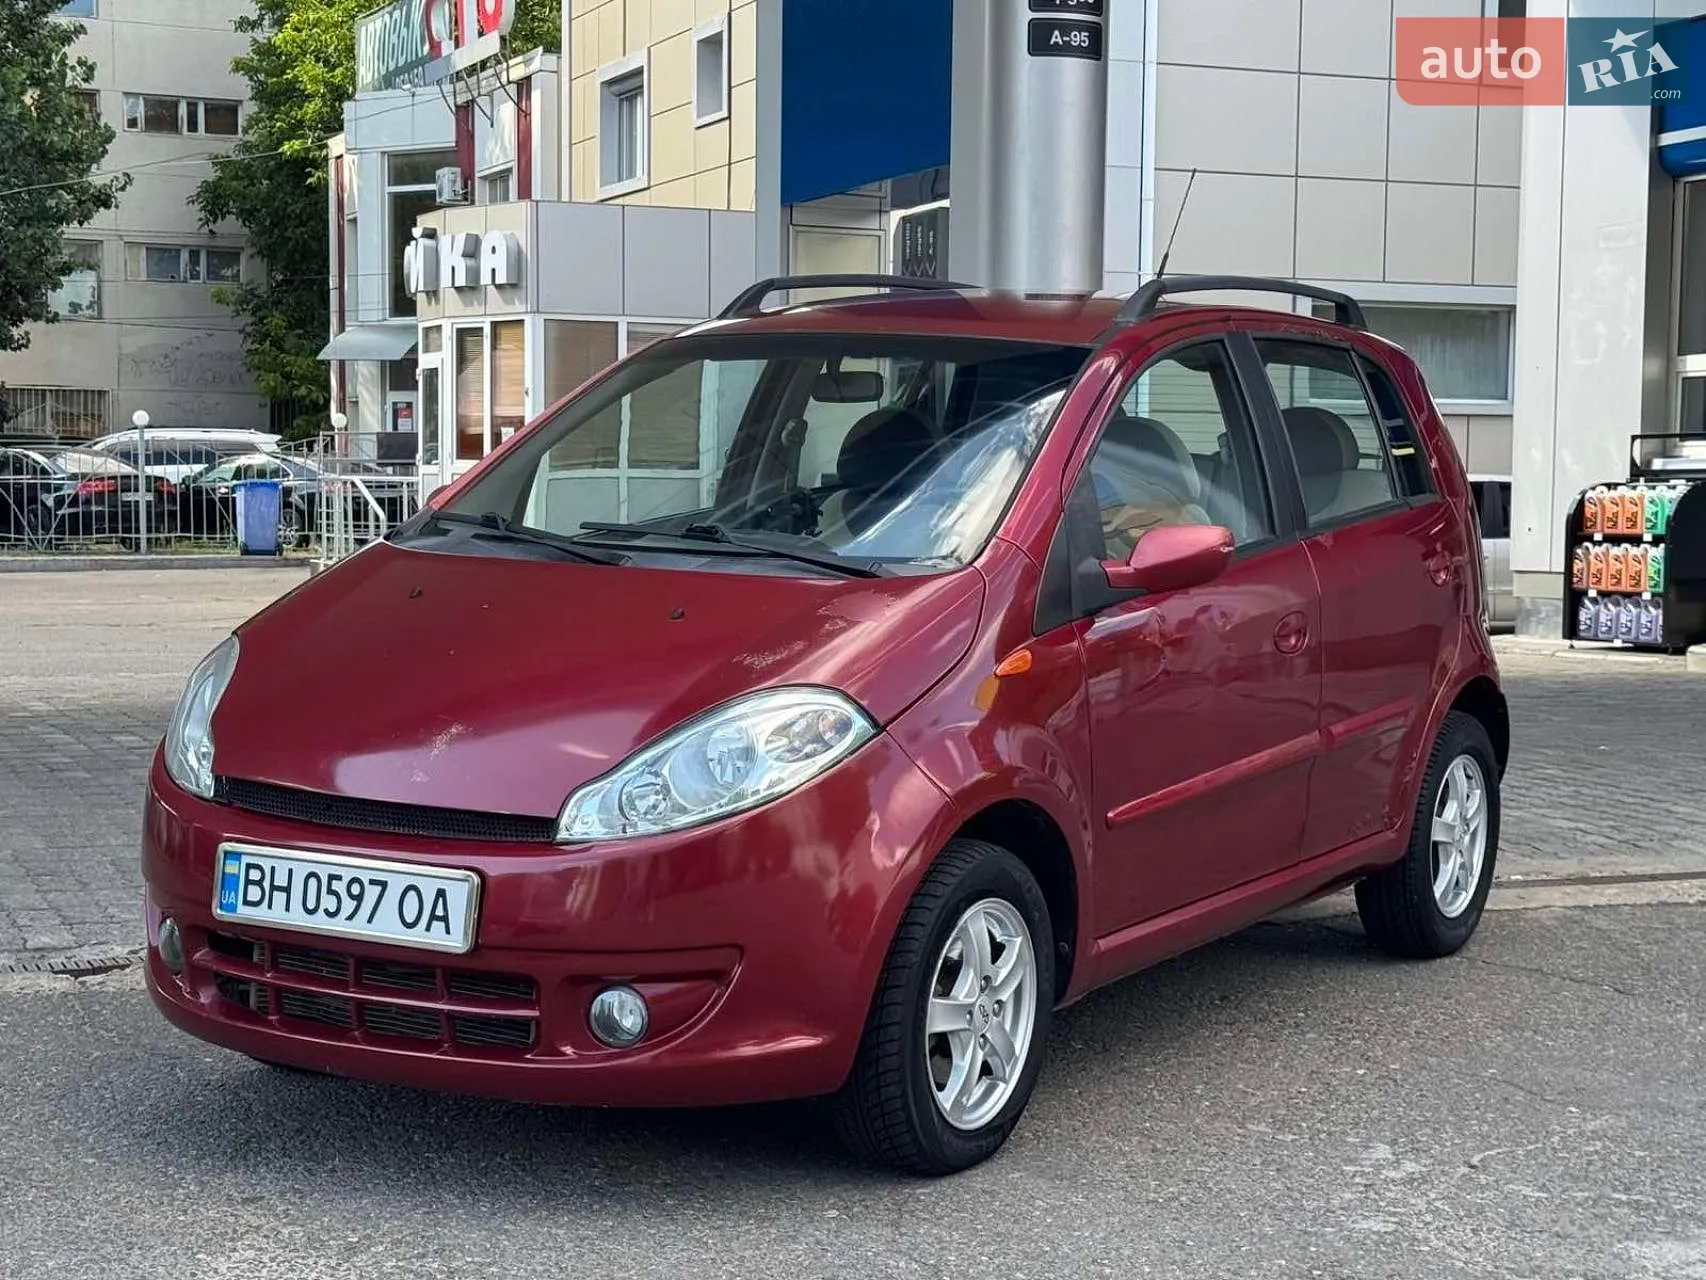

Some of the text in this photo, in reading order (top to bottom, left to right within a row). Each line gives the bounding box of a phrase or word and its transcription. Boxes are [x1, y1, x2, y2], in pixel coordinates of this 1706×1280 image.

[359, 0, 428, 88] АВТОВЫК
[221, 889, 237, 904] UA
[241, 862, 451, 935] BH 0597 OA
